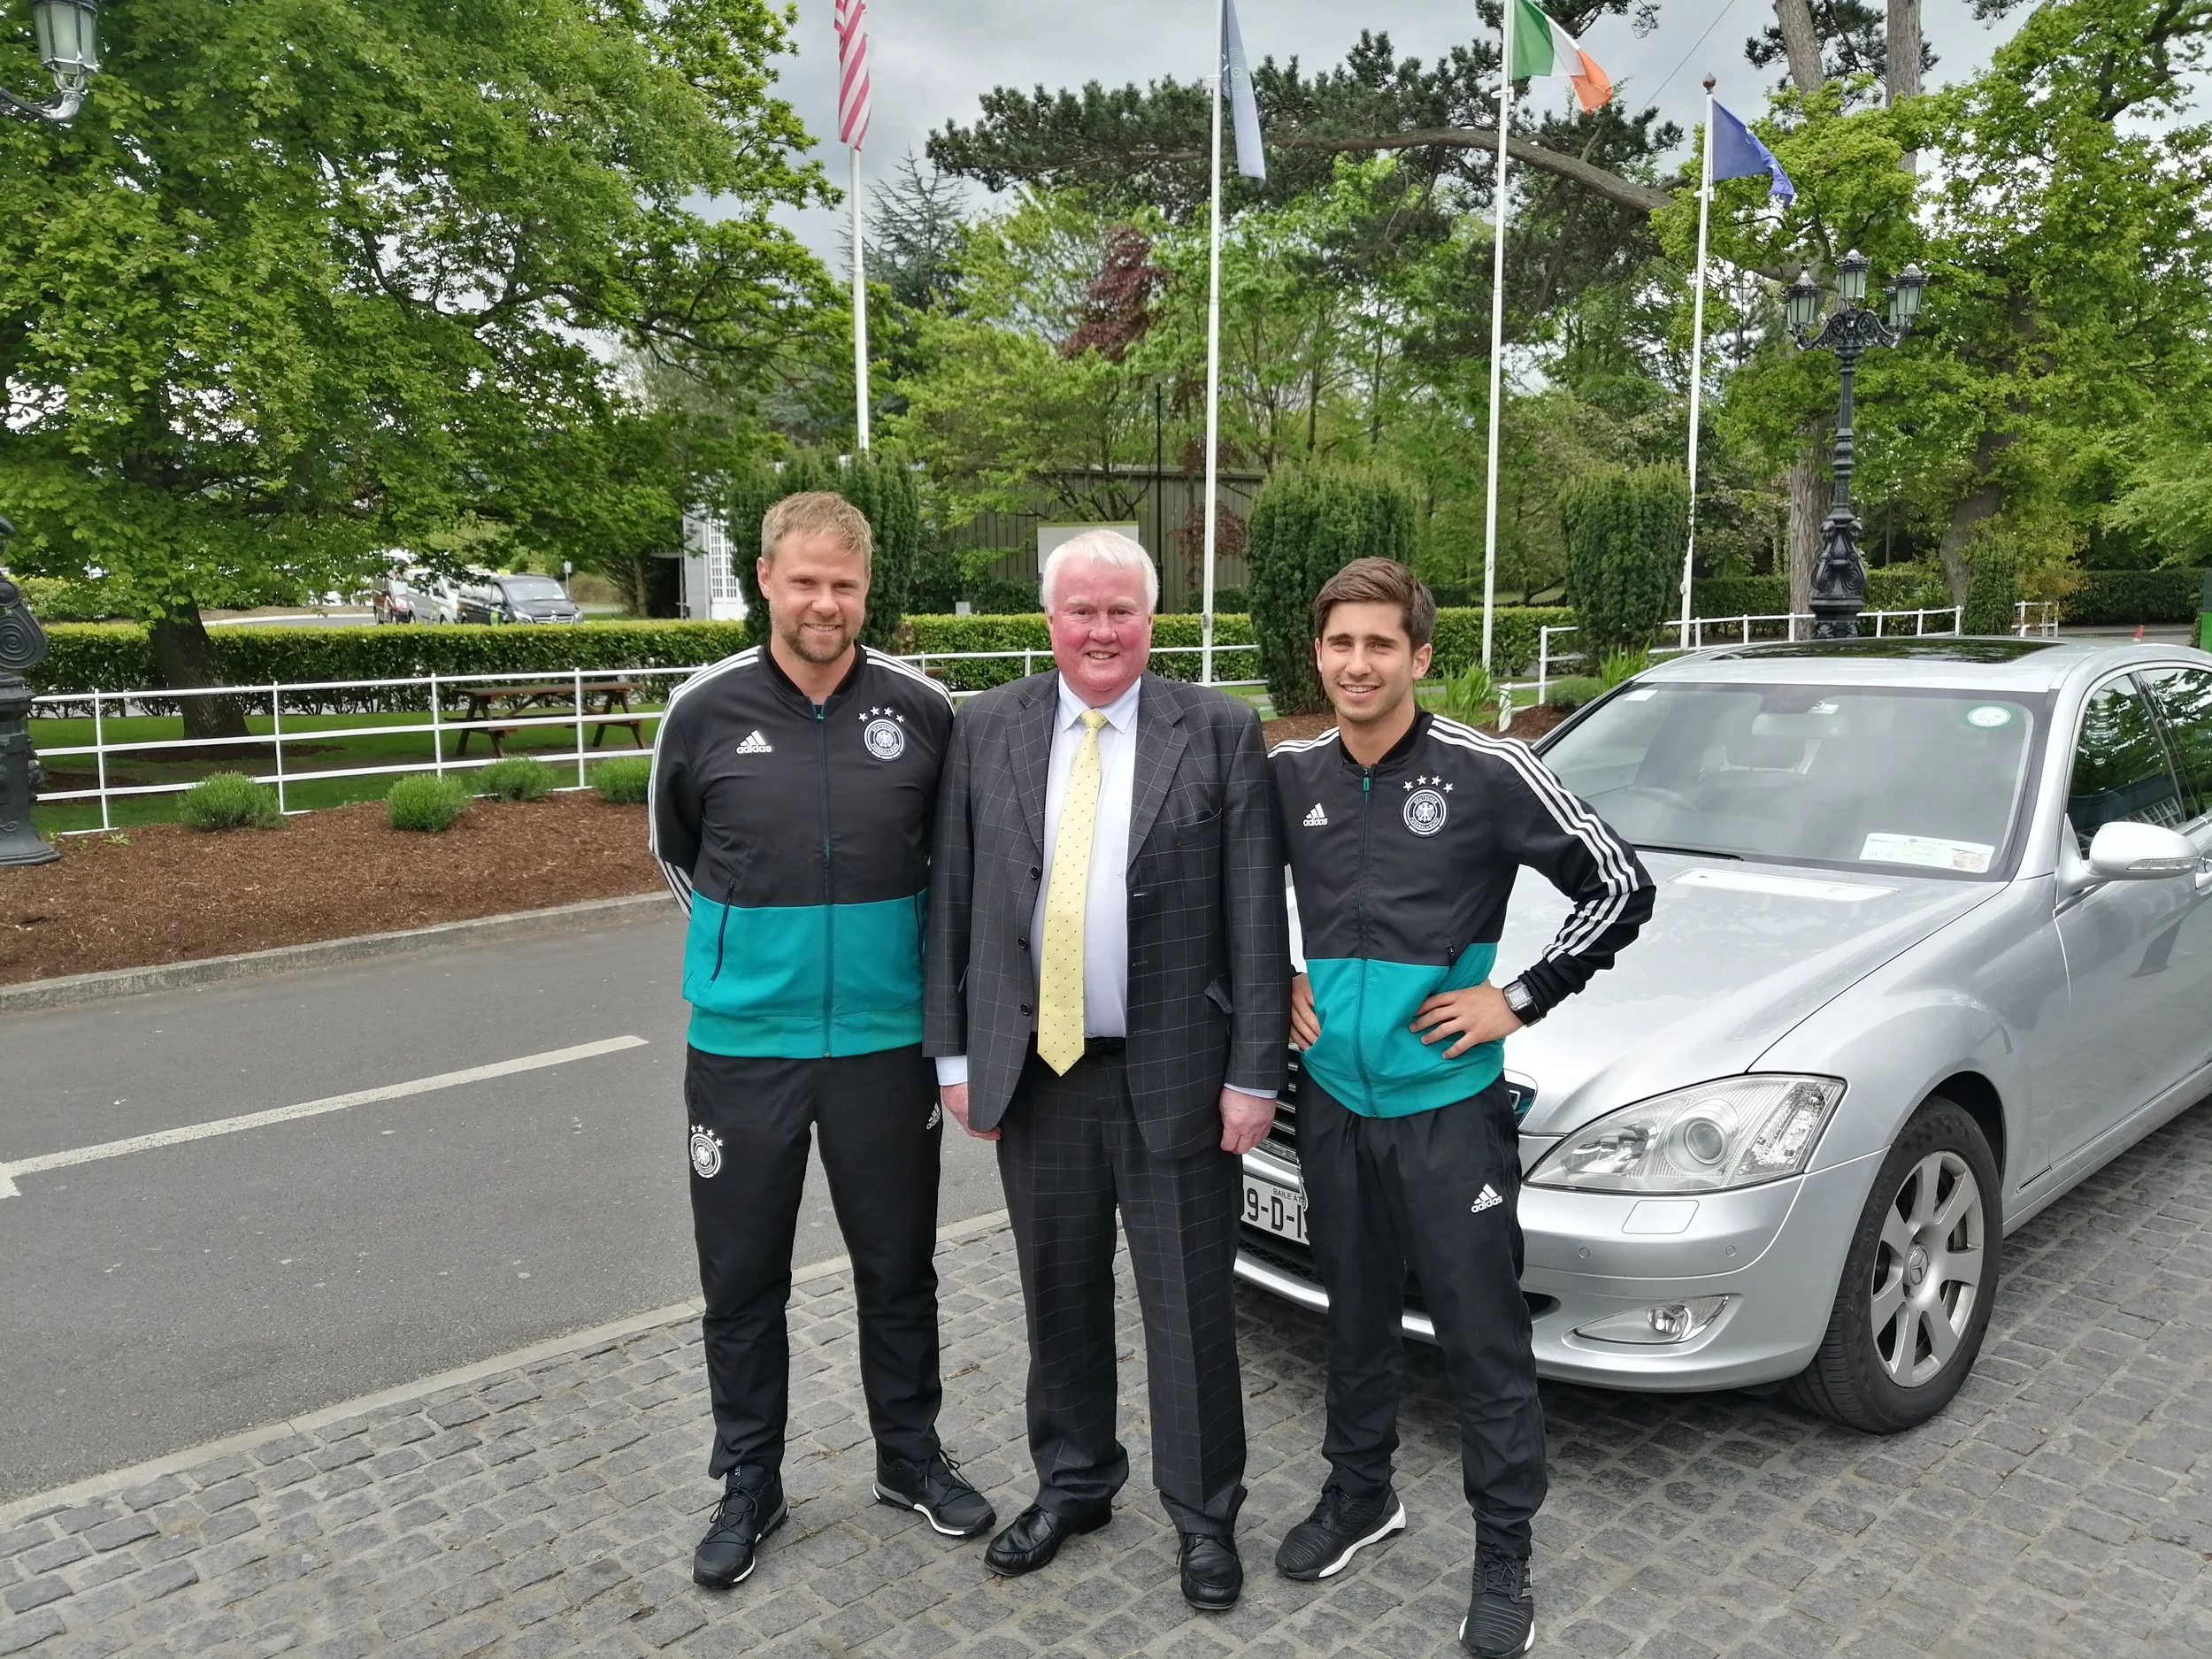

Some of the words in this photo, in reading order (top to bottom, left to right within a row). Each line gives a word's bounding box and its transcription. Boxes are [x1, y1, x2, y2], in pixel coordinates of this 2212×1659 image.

[736, 744, 772, 754] adidas
[1303, 818, 1327, 826] adidas
[1273, 1188, 1292, 1200] BAILE
[1471, 1195, 1502, 1213] adidas
[1242, 1187, 1307, 1239] 9-D-1
